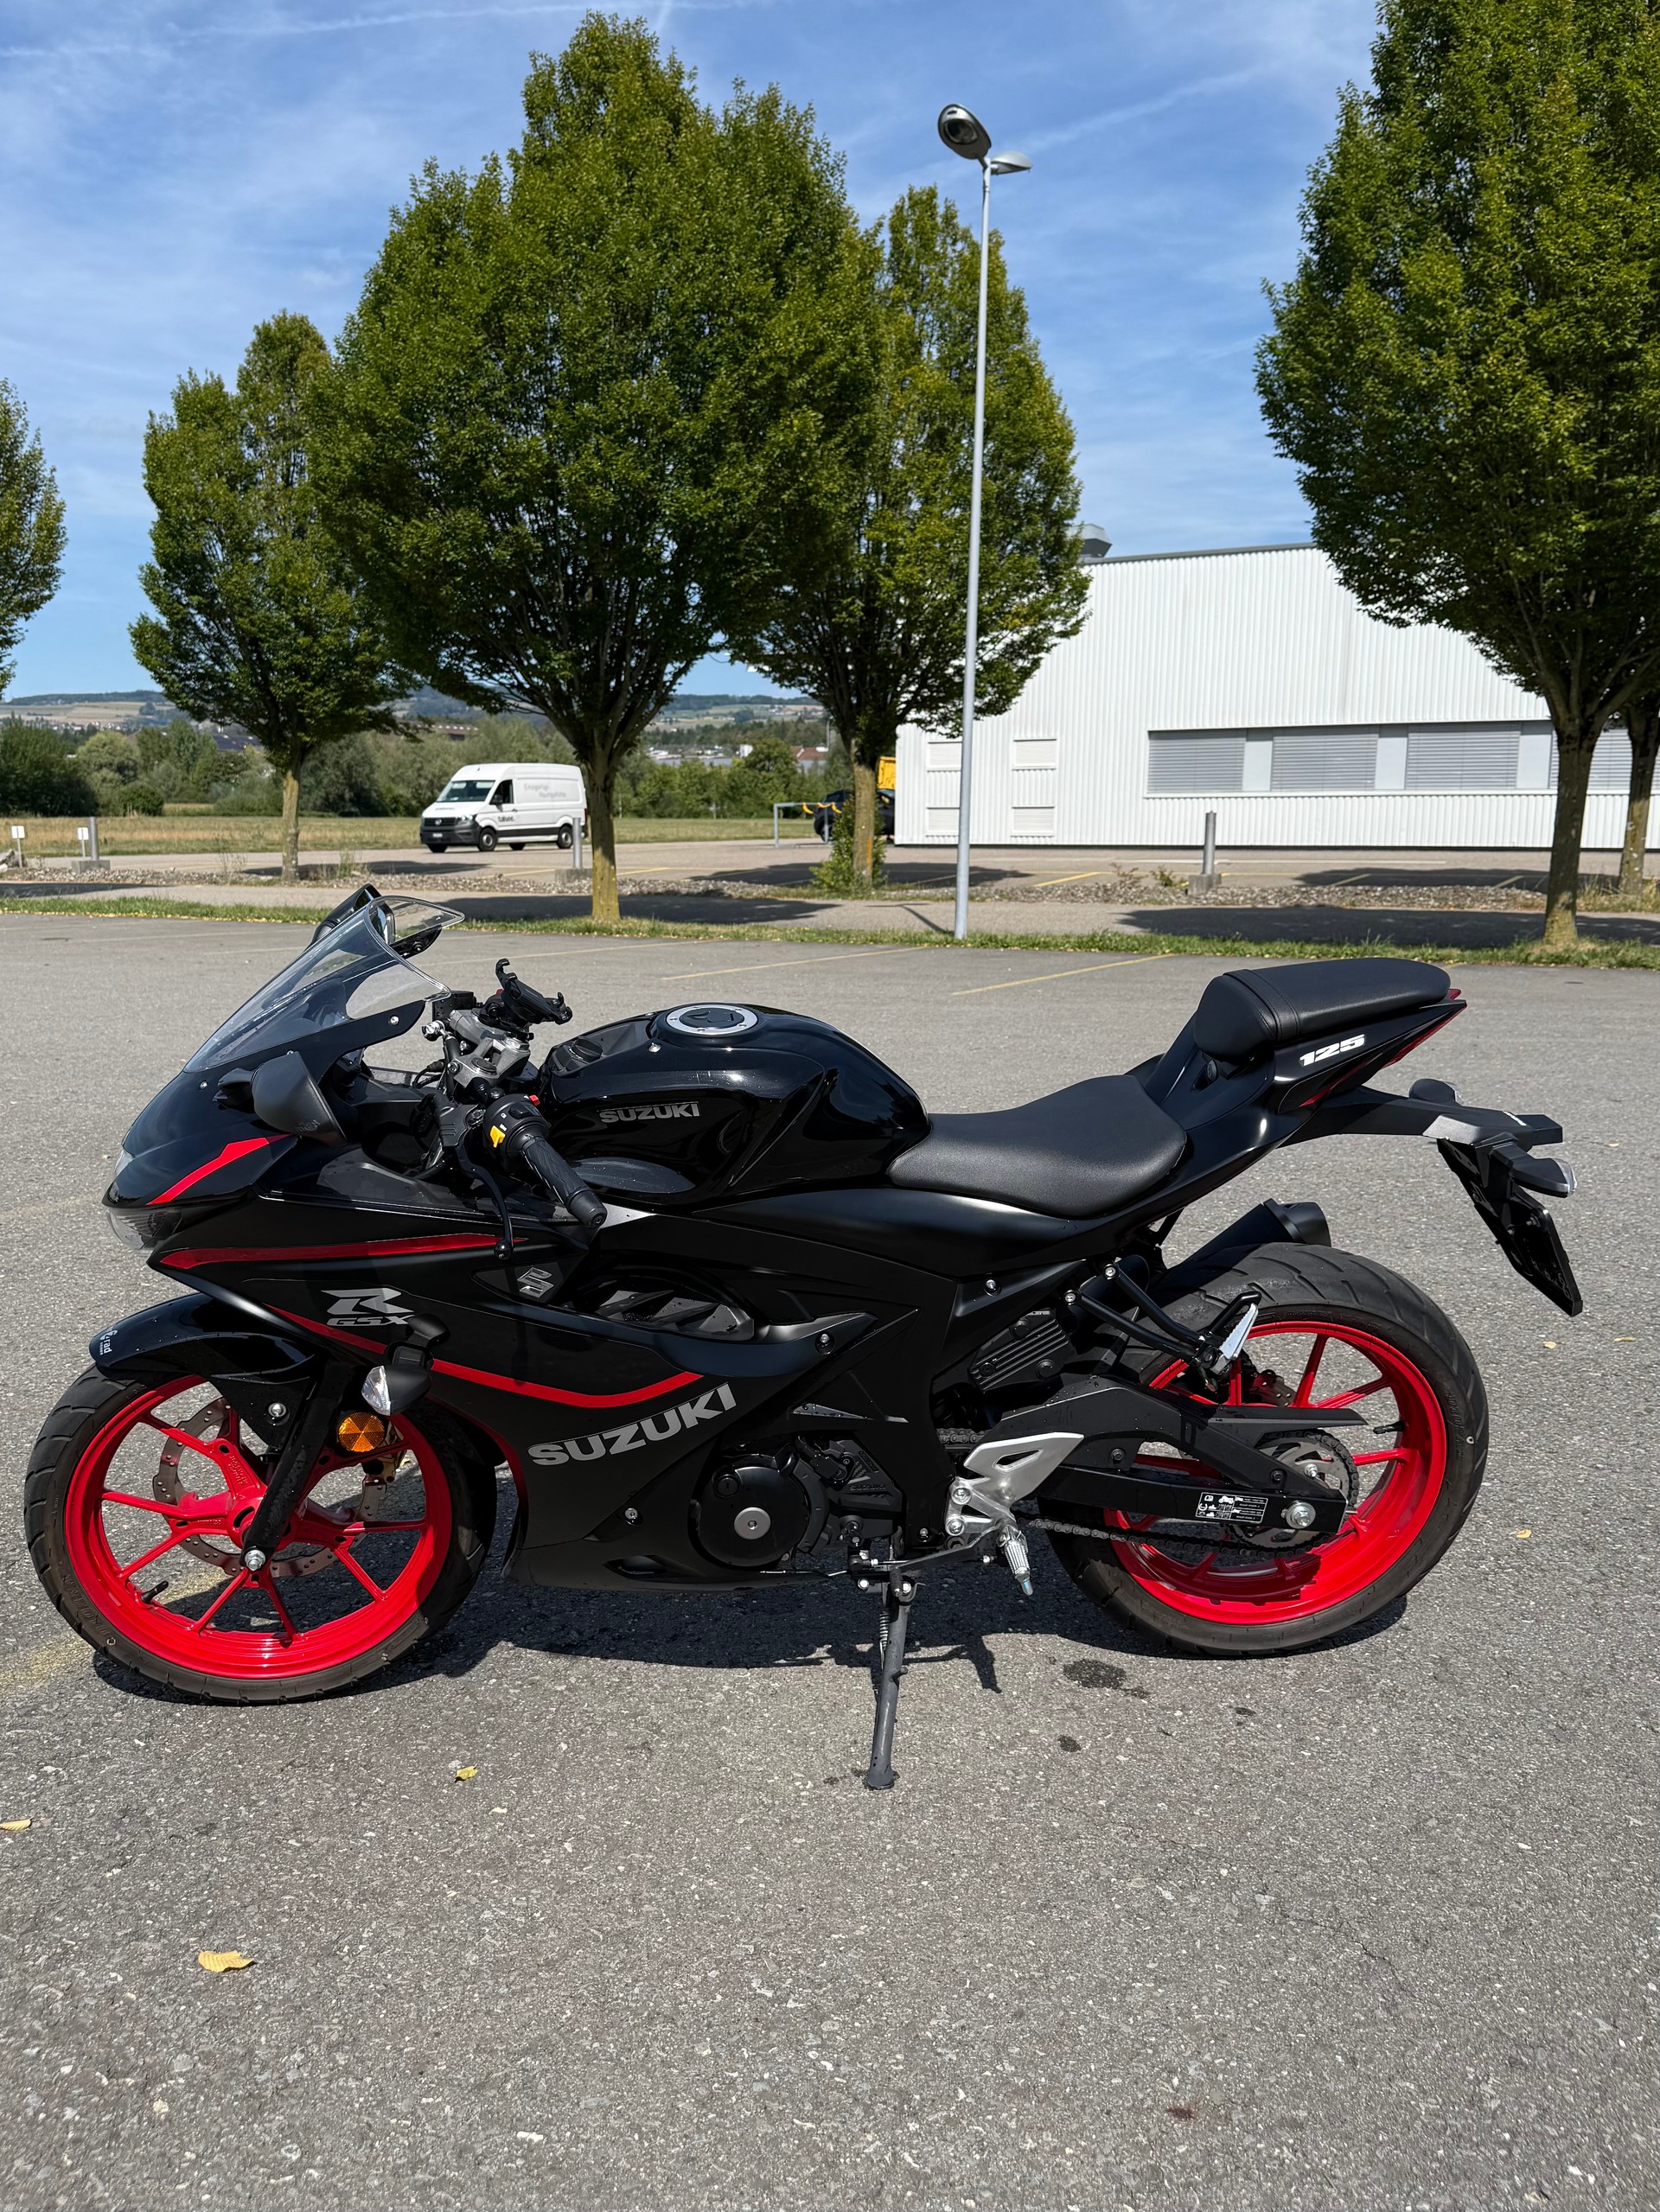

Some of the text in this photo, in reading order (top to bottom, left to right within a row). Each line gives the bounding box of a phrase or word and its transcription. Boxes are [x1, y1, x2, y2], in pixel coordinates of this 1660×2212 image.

[1299, 1034, 1365, 1067] 125
[598, 1101, 700, 1123] SUZUKI
[326, 1314, 415, 1327] GSX
[527, 1382, 737, 1466] SUZUKI
